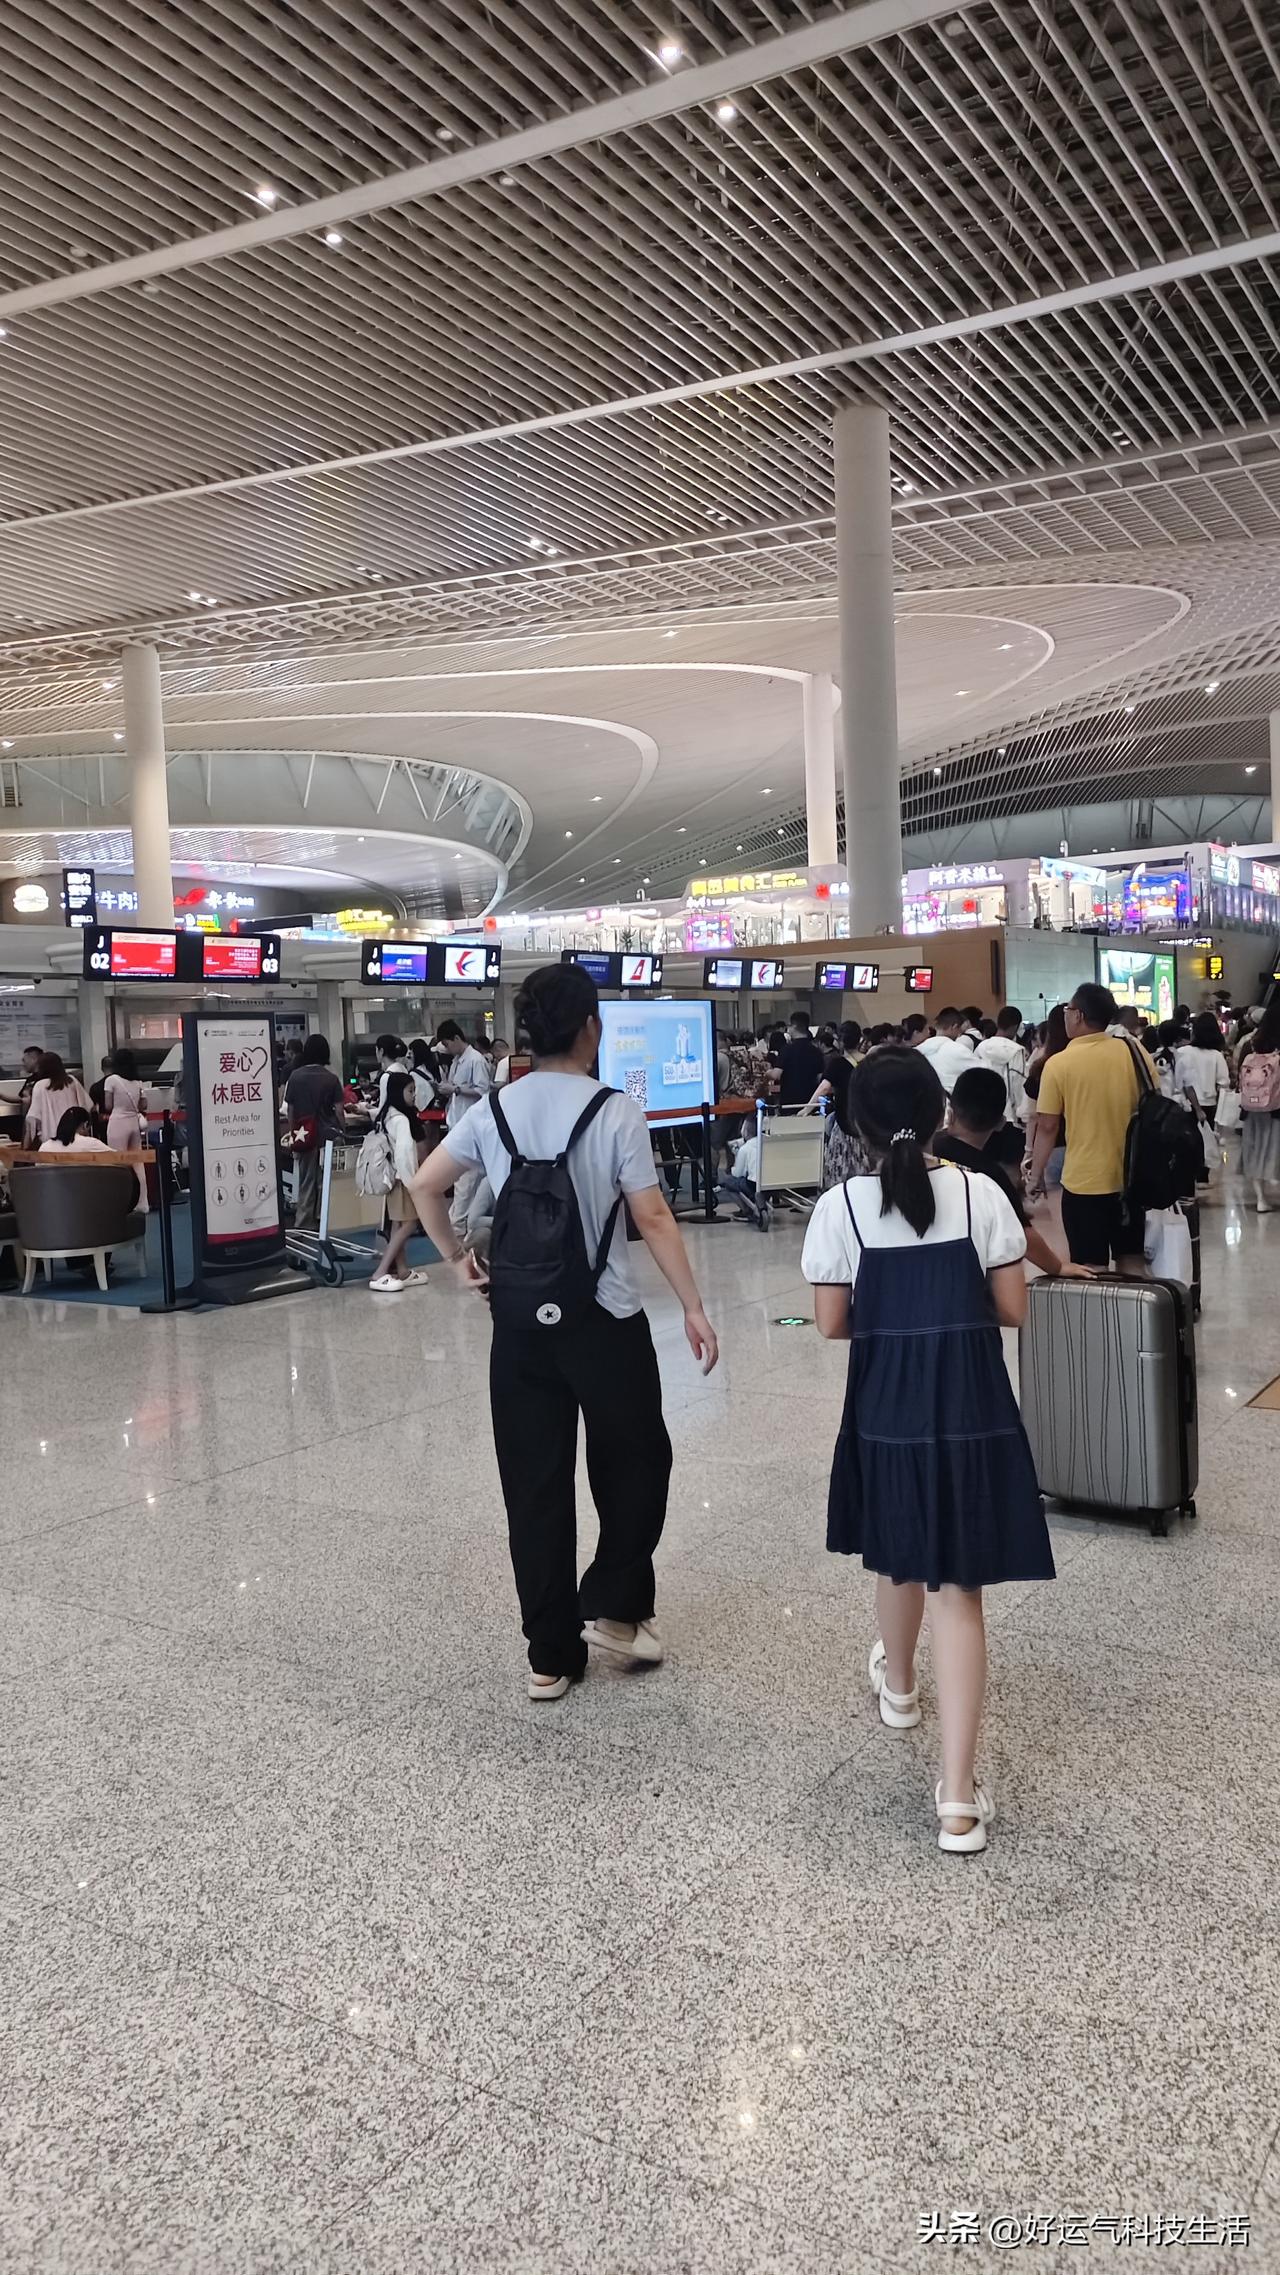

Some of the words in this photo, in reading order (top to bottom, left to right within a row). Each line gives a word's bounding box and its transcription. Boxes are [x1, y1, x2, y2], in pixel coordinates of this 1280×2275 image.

[97, 935, 105, 949] J
[267, 942, 274, 955] J
[90, 953, 110, 970] 02
[262, 958, 279, 973] 03
[219, 1052, 253, 1074] 爱心
[211, 1082, 263, 1105] 休息区
[214, 1114, 231, 1125] Rest
[232, 1113, 250, 1123] Area
[250, 1112, 261, 1122] for
[222, 1127, 255, 1137] Priorities
